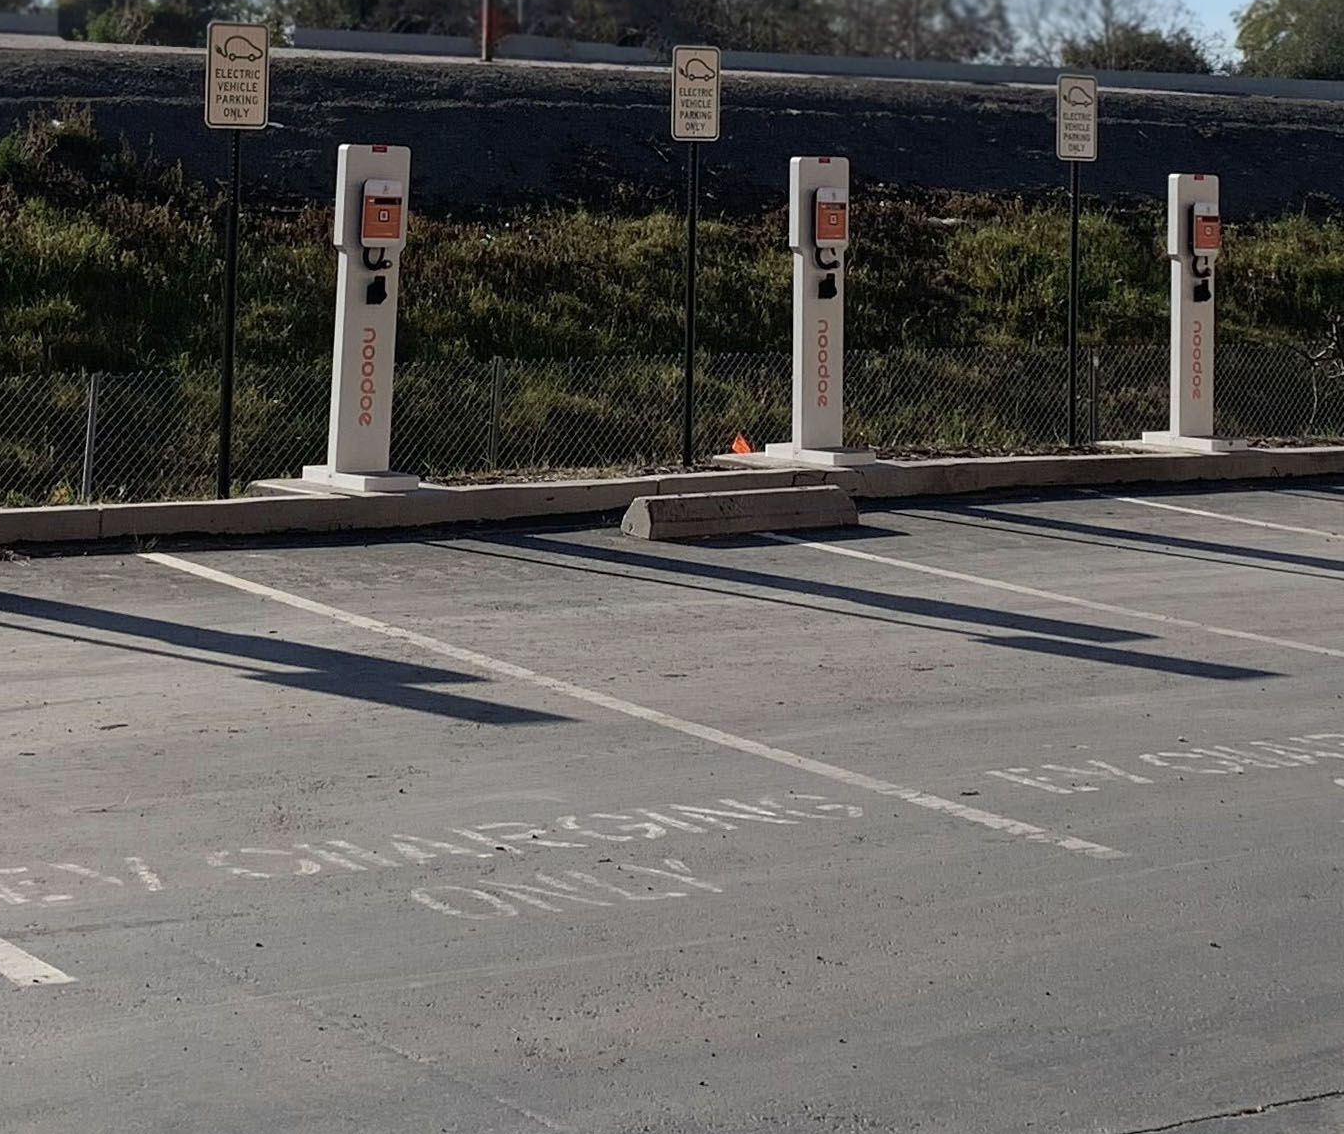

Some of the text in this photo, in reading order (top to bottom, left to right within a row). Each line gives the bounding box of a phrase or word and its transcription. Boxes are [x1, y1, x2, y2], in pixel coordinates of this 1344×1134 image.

[216, 68, 260, 79] ELECTRIC
[218, 81, 258, 92] VEHICLE
[679, 87, 713, 97] ELECTRIC
[216, 94, 258, 105] PARKING
[680, 99, 712, 108] VEHICLE
[224, 107, 249, 118] ONLY
[679, 110, 712, 120] PARKING
[685, 122, 705, 131] ONLY
[817, 319, 831, 408] noodoe
[358, 327, 376, 427] noodoe
[410, 858, 724, 920] ONLY
